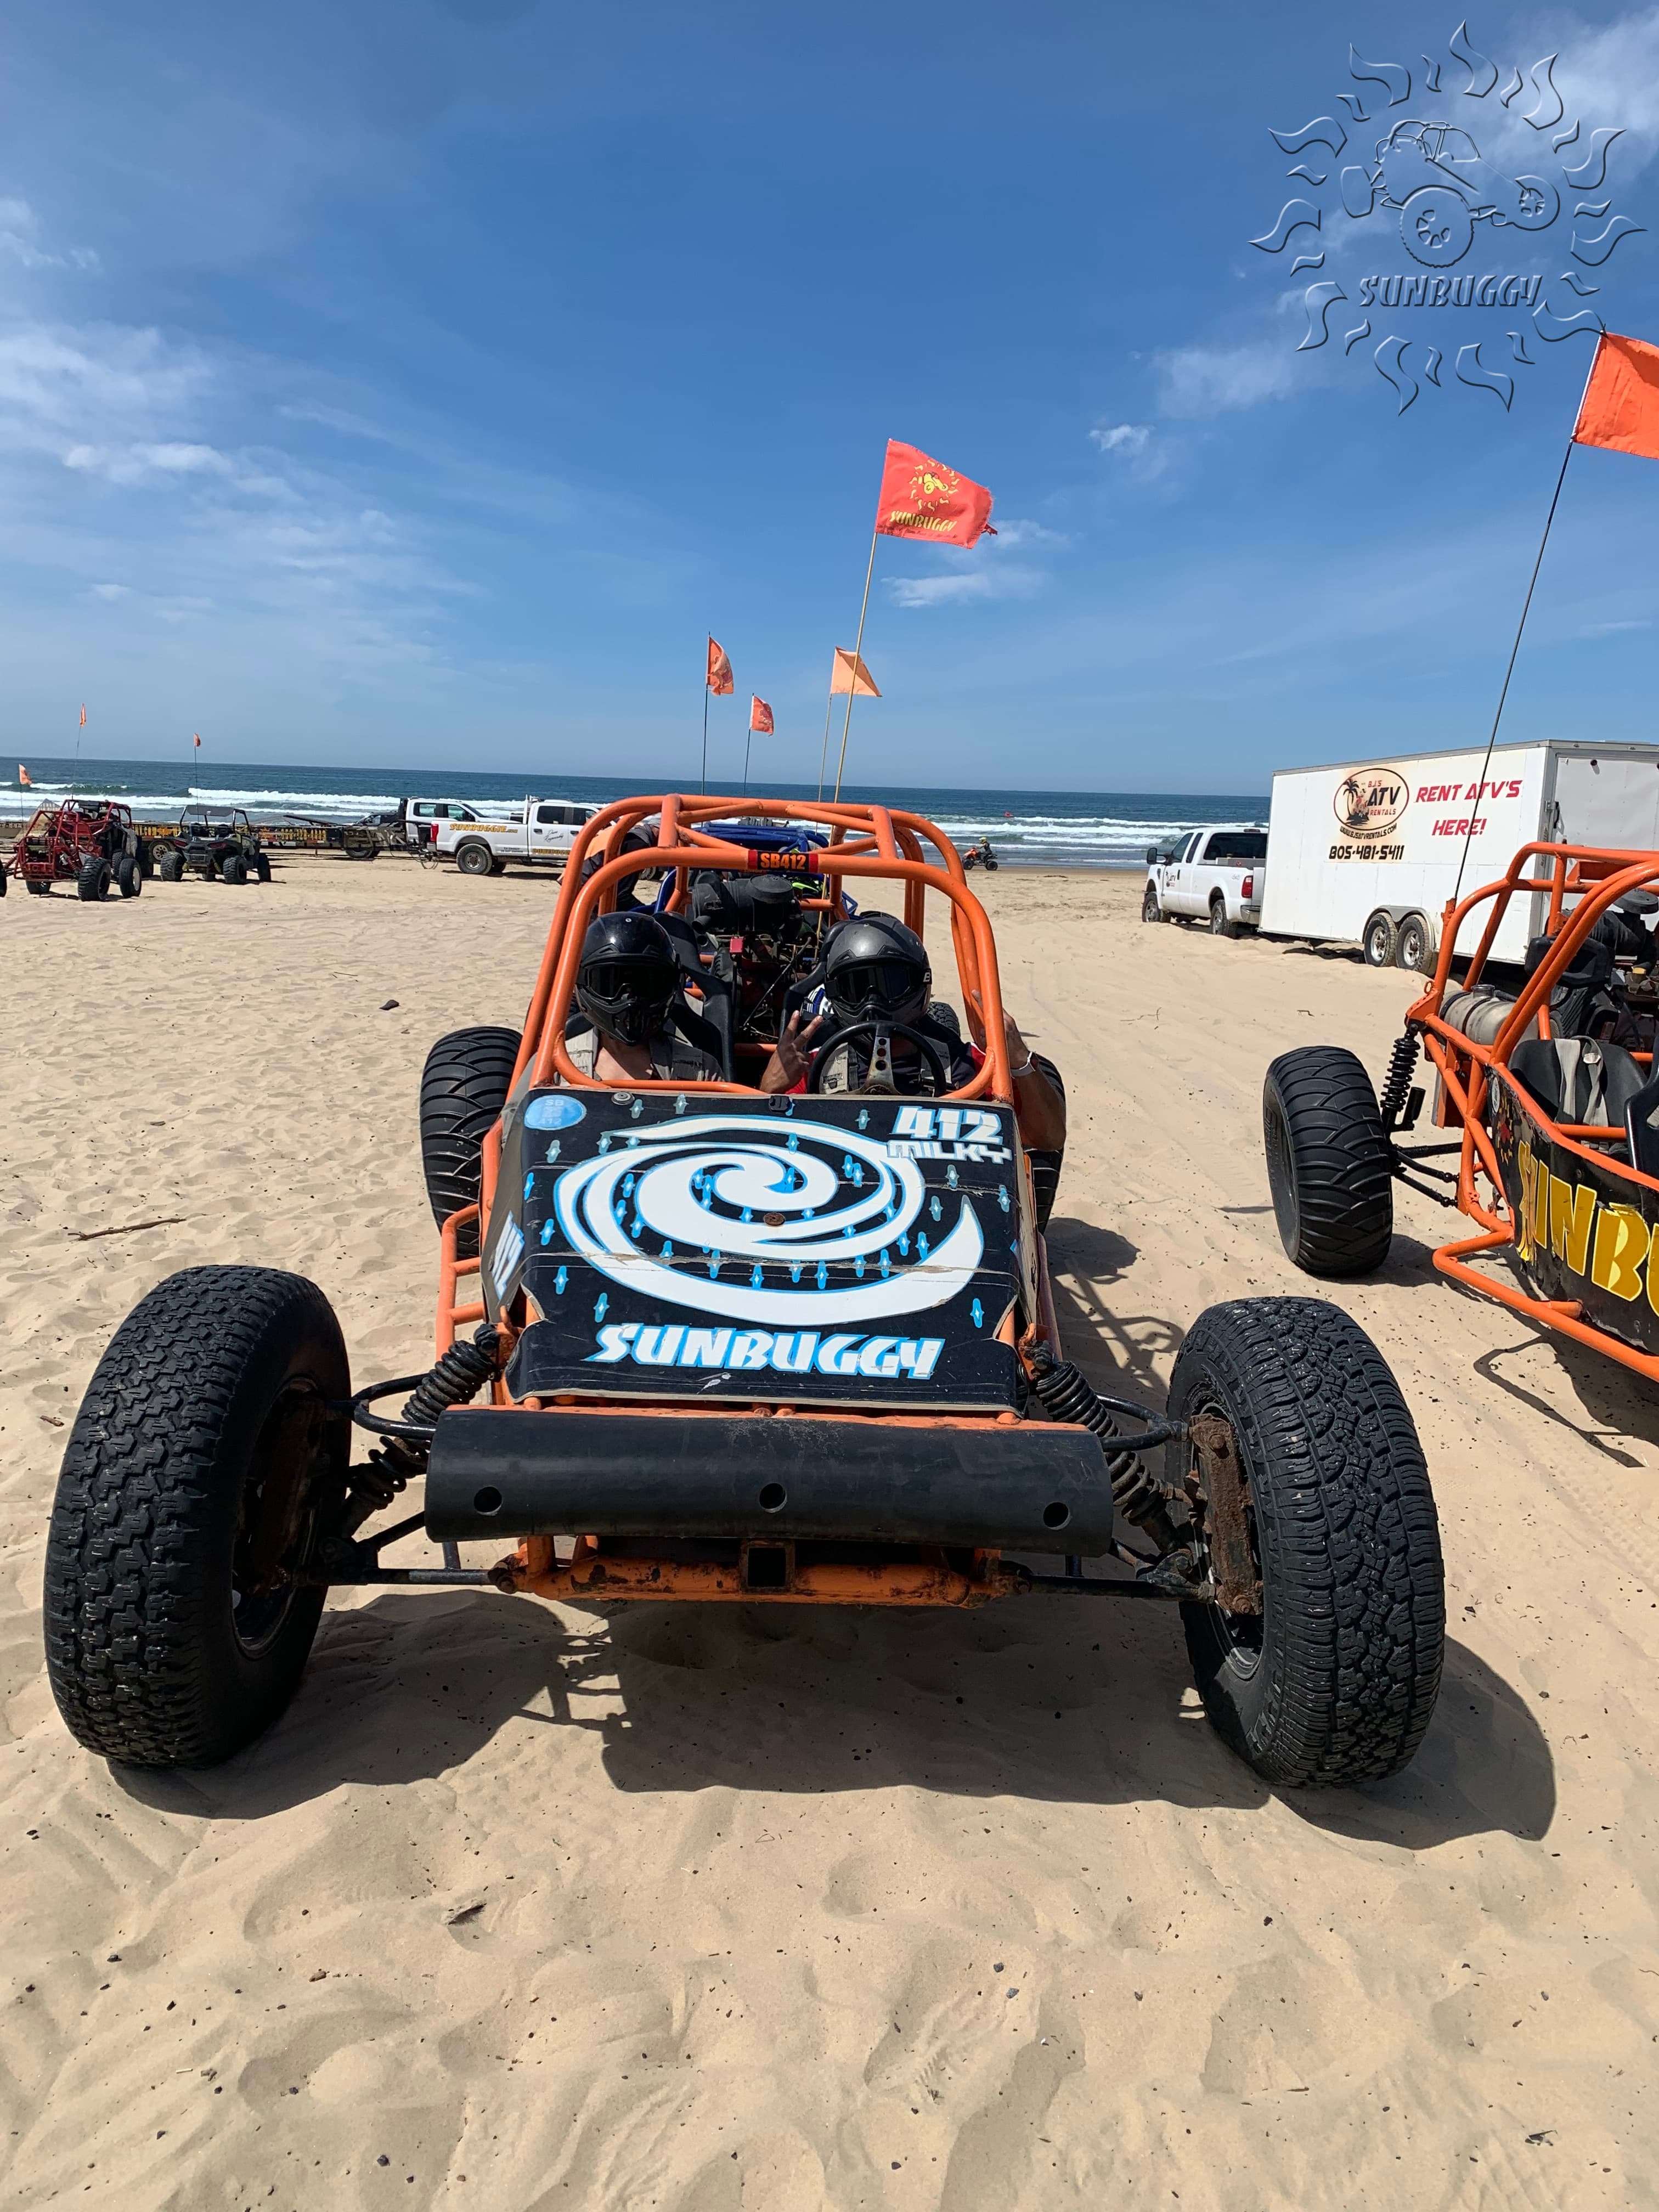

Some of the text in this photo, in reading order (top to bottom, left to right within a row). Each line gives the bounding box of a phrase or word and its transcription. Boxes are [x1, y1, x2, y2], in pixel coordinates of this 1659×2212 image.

[889, 510, 957, 532] SUNBUGGY
[1367, 786, 1401, 806] ATV
[1415, 780, 1522, 803] RENT ATV'S
[1431, 818, 1487, 836] HERE!
[760, 853, 806, 870] SB412
[1329, 845, 1404, 860] 805-481-5411
[890, 1105, 1003, 1145] 412
[887, 1139, 1013, 1165] MILKY
[1516, 1140, 1659, 1318] SUNB
[581, 1323, 945, 1380] SUNBUGGY
